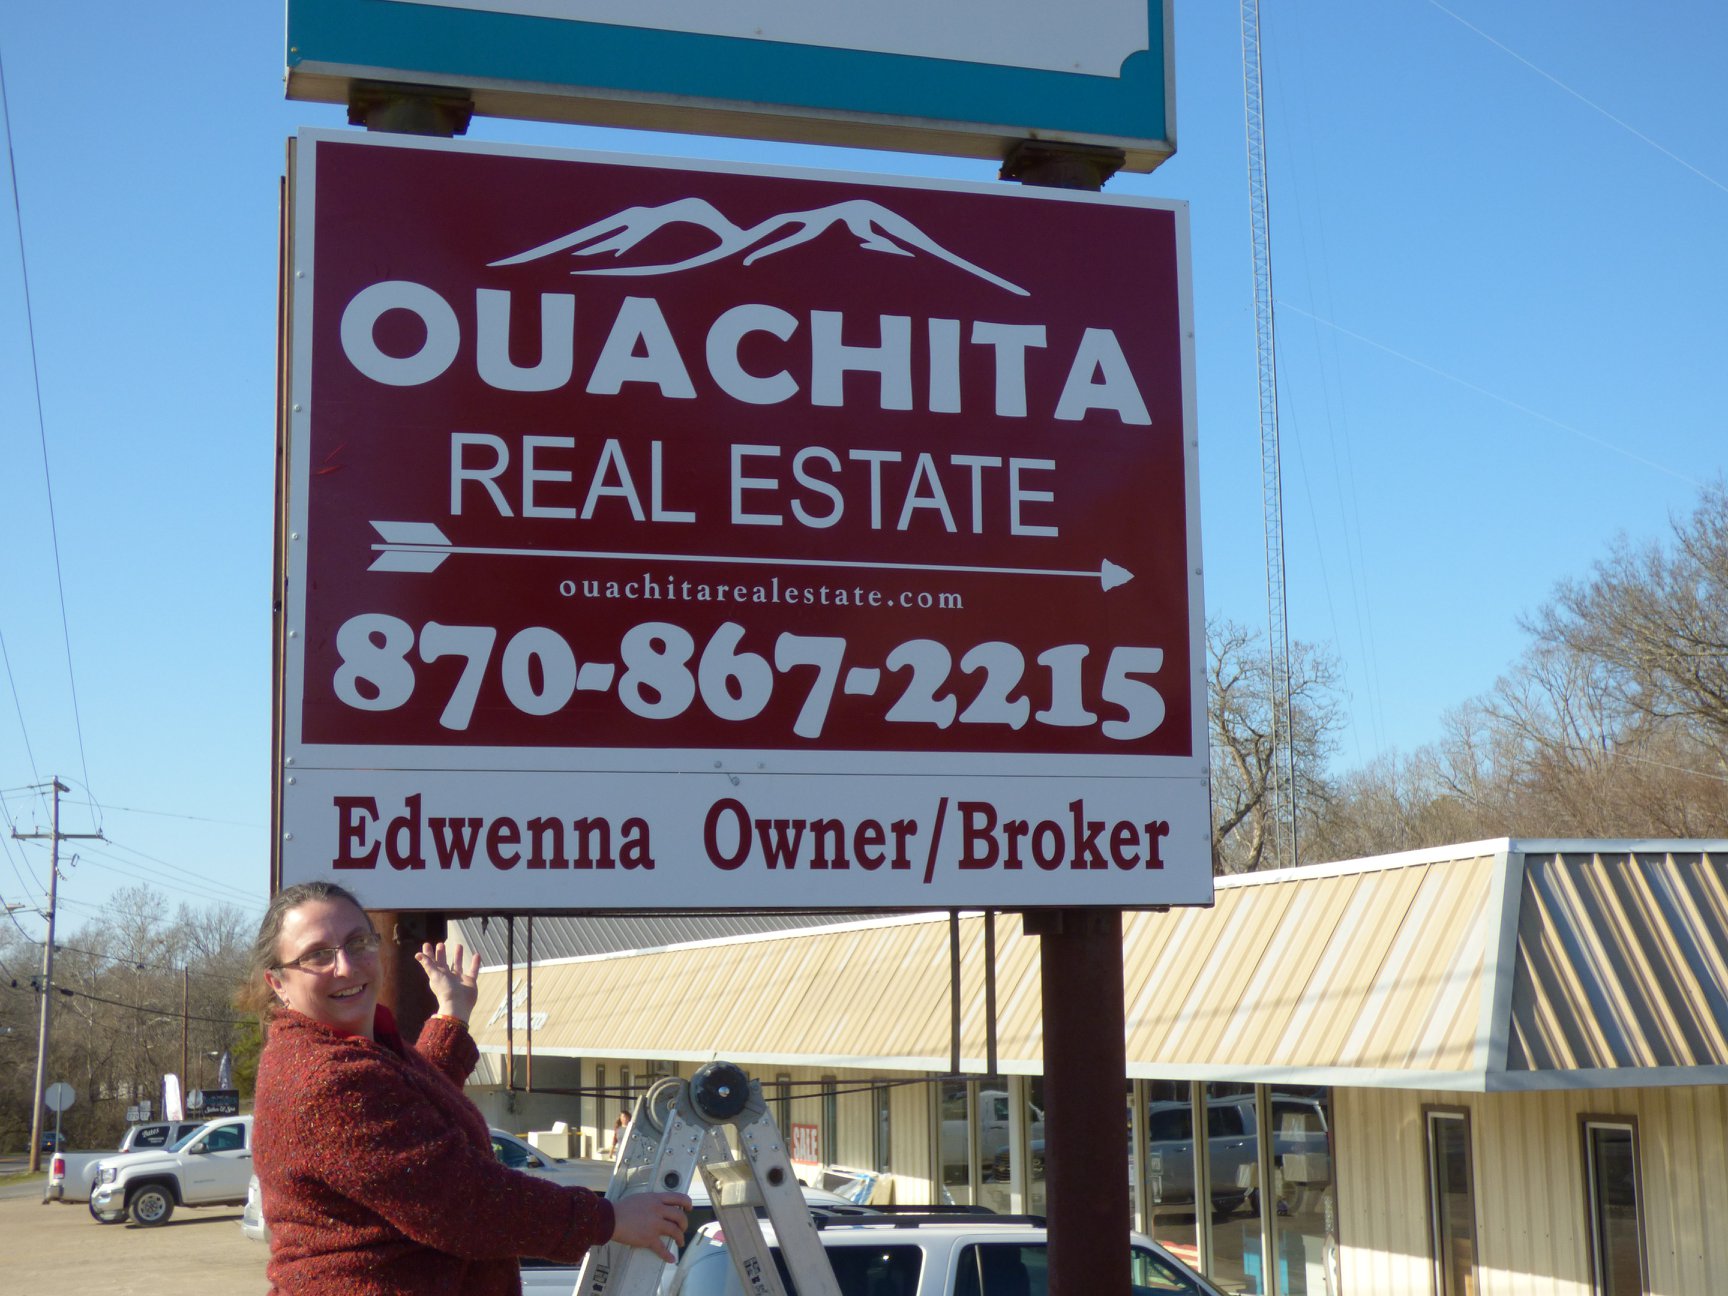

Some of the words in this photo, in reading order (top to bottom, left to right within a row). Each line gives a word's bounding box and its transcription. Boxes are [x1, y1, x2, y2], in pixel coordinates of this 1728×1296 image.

[341, 281, 1153, 426] OUACHITA
[450, 432, 696, 523] REAL
[731, 444, 1059, 538] ESTATE
[559, 573, 964, 609] ouachitarealestate.com
[333, 613, 1166, 740] 870-867-2215
[333, 793, 656, 870] Edwenna
[704, 797, 1170, 883] Owner/Broker
[793, 1126, 818, 1162] SALE
